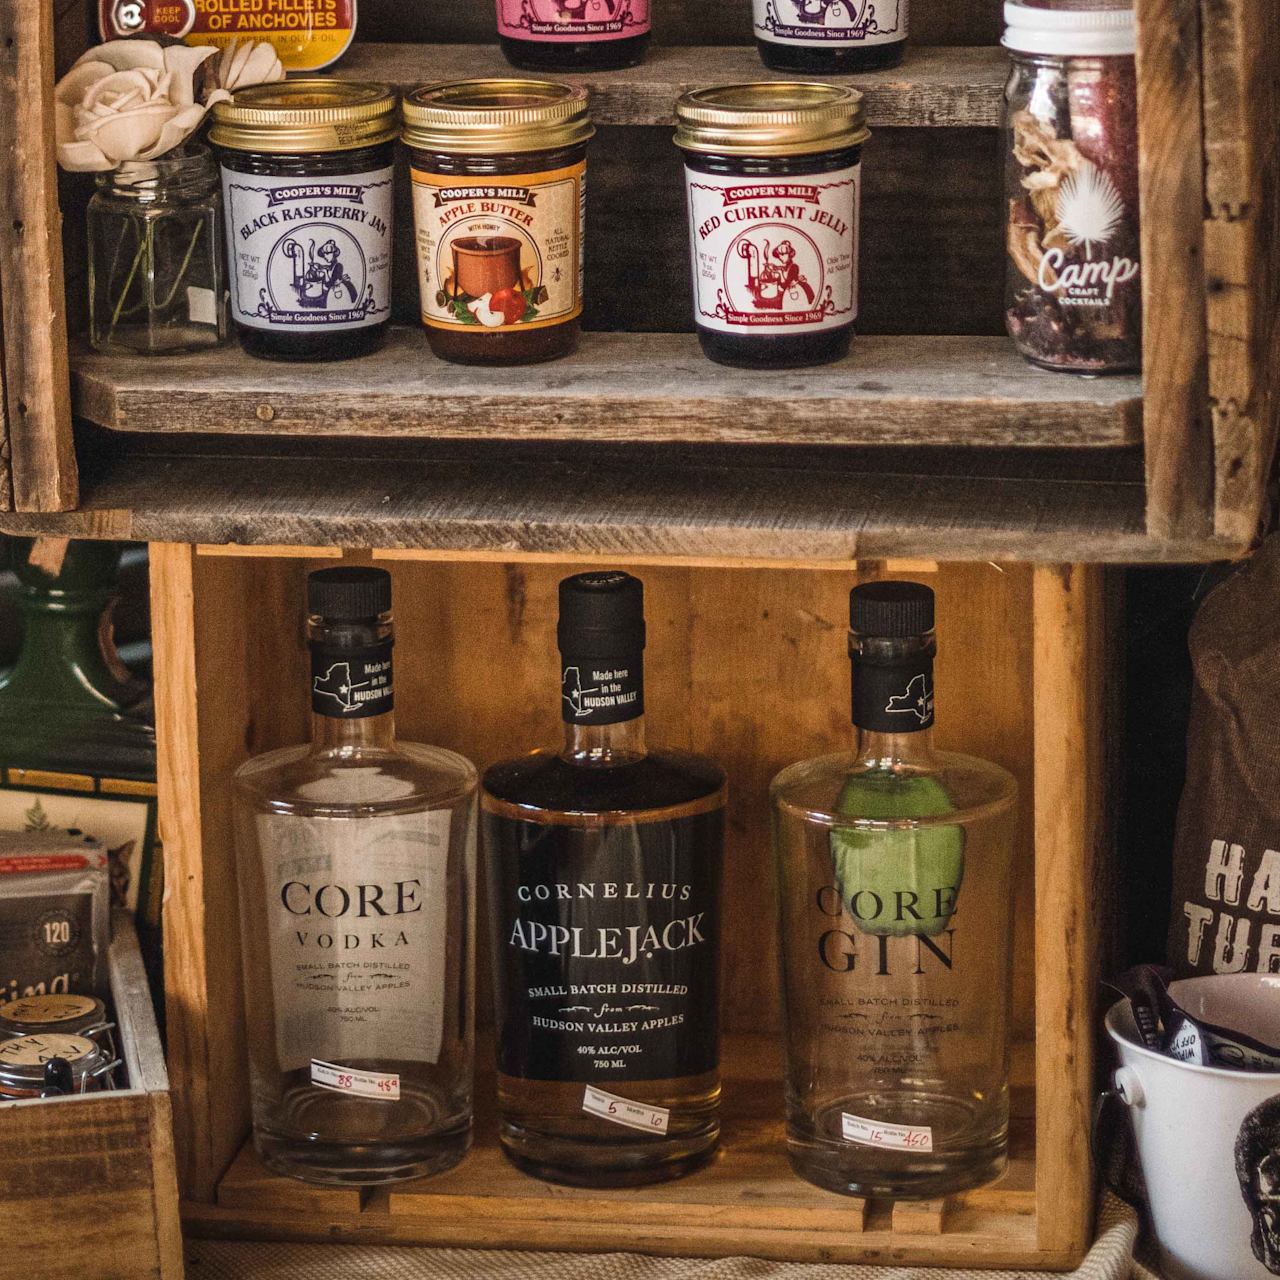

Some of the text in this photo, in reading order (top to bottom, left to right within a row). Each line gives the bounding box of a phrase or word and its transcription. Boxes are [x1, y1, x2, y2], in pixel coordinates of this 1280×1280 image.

[156, 6, 181, 15] KEEP
[153, 15, 180, 24] COOL
[209, 12, 337, 29] OF ANCHOVIES
[532, 22, 621, 32] Simple Goodness Since 1969
[775, 27, 864, 38] Simple Goodness Since 1969
[275, 187, 359, 199] COOPER'S MILL
[441, 189, 526, 198] COOPER'S MILL
[730, 187, 814, 198] COOPER'S MILL
[439, 202, 534, 227] APPLE BUTTER
[240, 206, 387, 240] BLACK RASPBERRY JAM
[699, 206, 849, 240] RED CURRANT JELLY
[1038, 247, 1139, 299] Camp
[1069, 286, 1099, 296] CRAFT
[1058, 297, 1110, 306] COCKTAILS
[271, 312, 293, 322] Simple
[294, 313, 327, 321] Goodness
[348, 311, 364, 319] 1969
[728, 313, 748, 322] Simple
[749, 314, 783, 322] Goodness
[805, 312, 822, 320] 1969
[592, 669, 628, 680] Made here
[601, 683, 621, 693] in the
[584, 691, 637, 707] HUDSON VALLEY
[518, 883, 691, 901] CORNELIUS
[281, 879, 422, 918] CORE
[816, 885, 958, 921] CORE
[44, 922, 70, 943] 120
[510, 912, 705, 965] APPLEJACK
[296, 931, 409, 950] VODKA
[818, 929, 957, 976] GIN
[363, 962, 410, 970] DISTILLED
[529, 983, 688, 998] SMALL BATCH DISTILLED
[594, 1003, 623, 1018] from
[533, 1014, 684, 1033] HUDSON VALLEY APPLES
[577, 1045, 642, 1055] 40% ALC/VOL
[594, 1060, 626, 1068] 750 ML
[608, 1101, 619, 1113] 5
